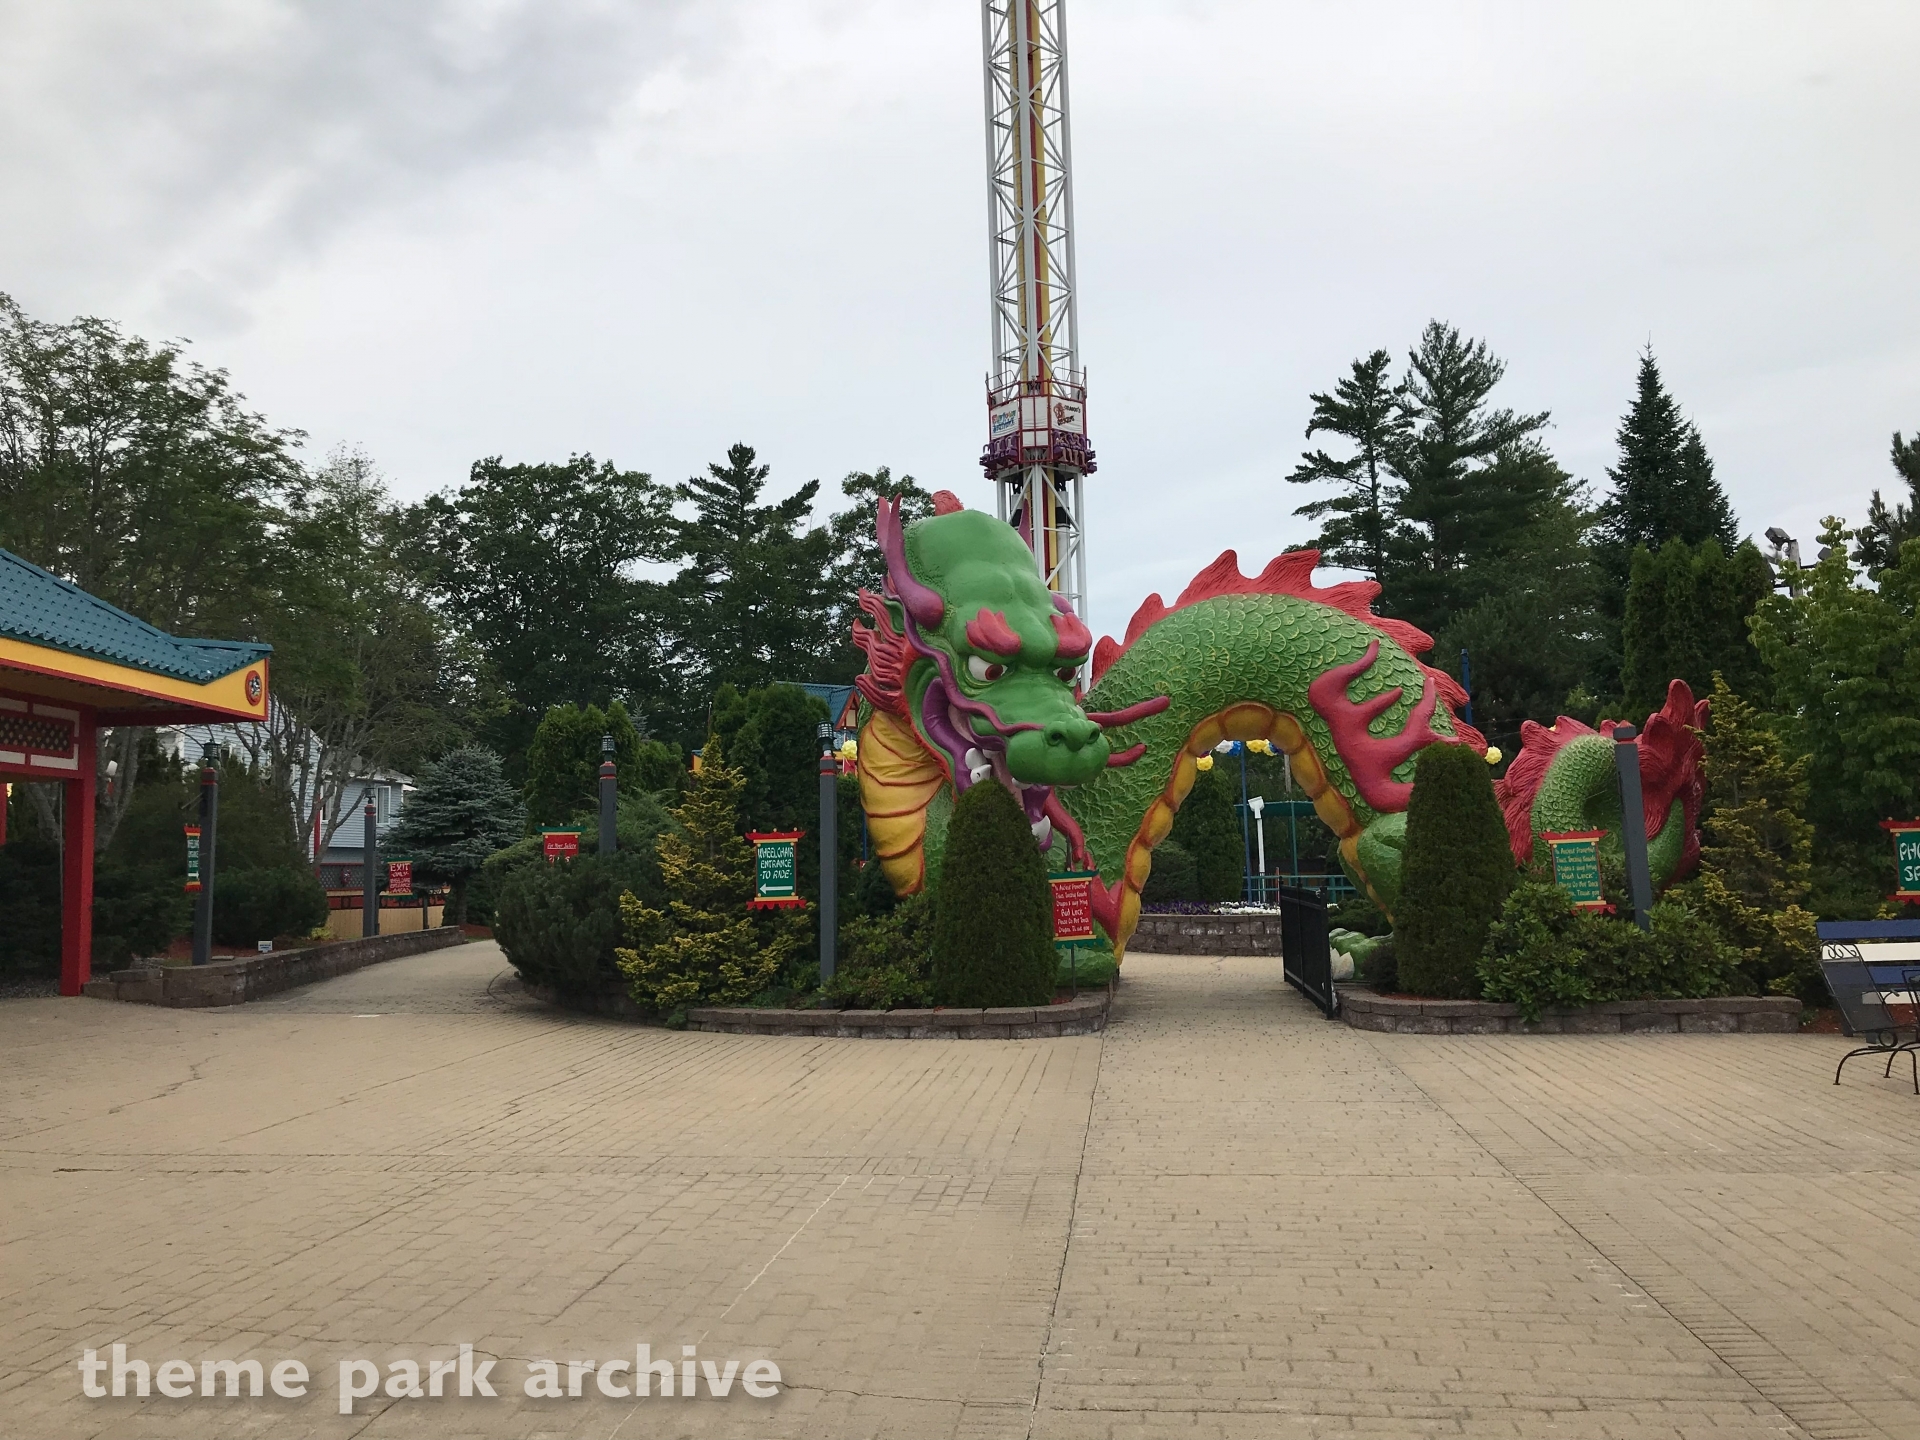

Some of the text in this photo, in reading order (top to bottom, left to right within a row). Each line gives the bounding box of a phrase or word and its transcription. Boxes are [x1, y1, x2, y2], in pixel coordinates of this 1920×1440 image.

[758, 847, 794, 858] WHEELCHAIR
[390, 863, 410, 871] EXIT
[760, 859, 791, 868] ENTRANCE
